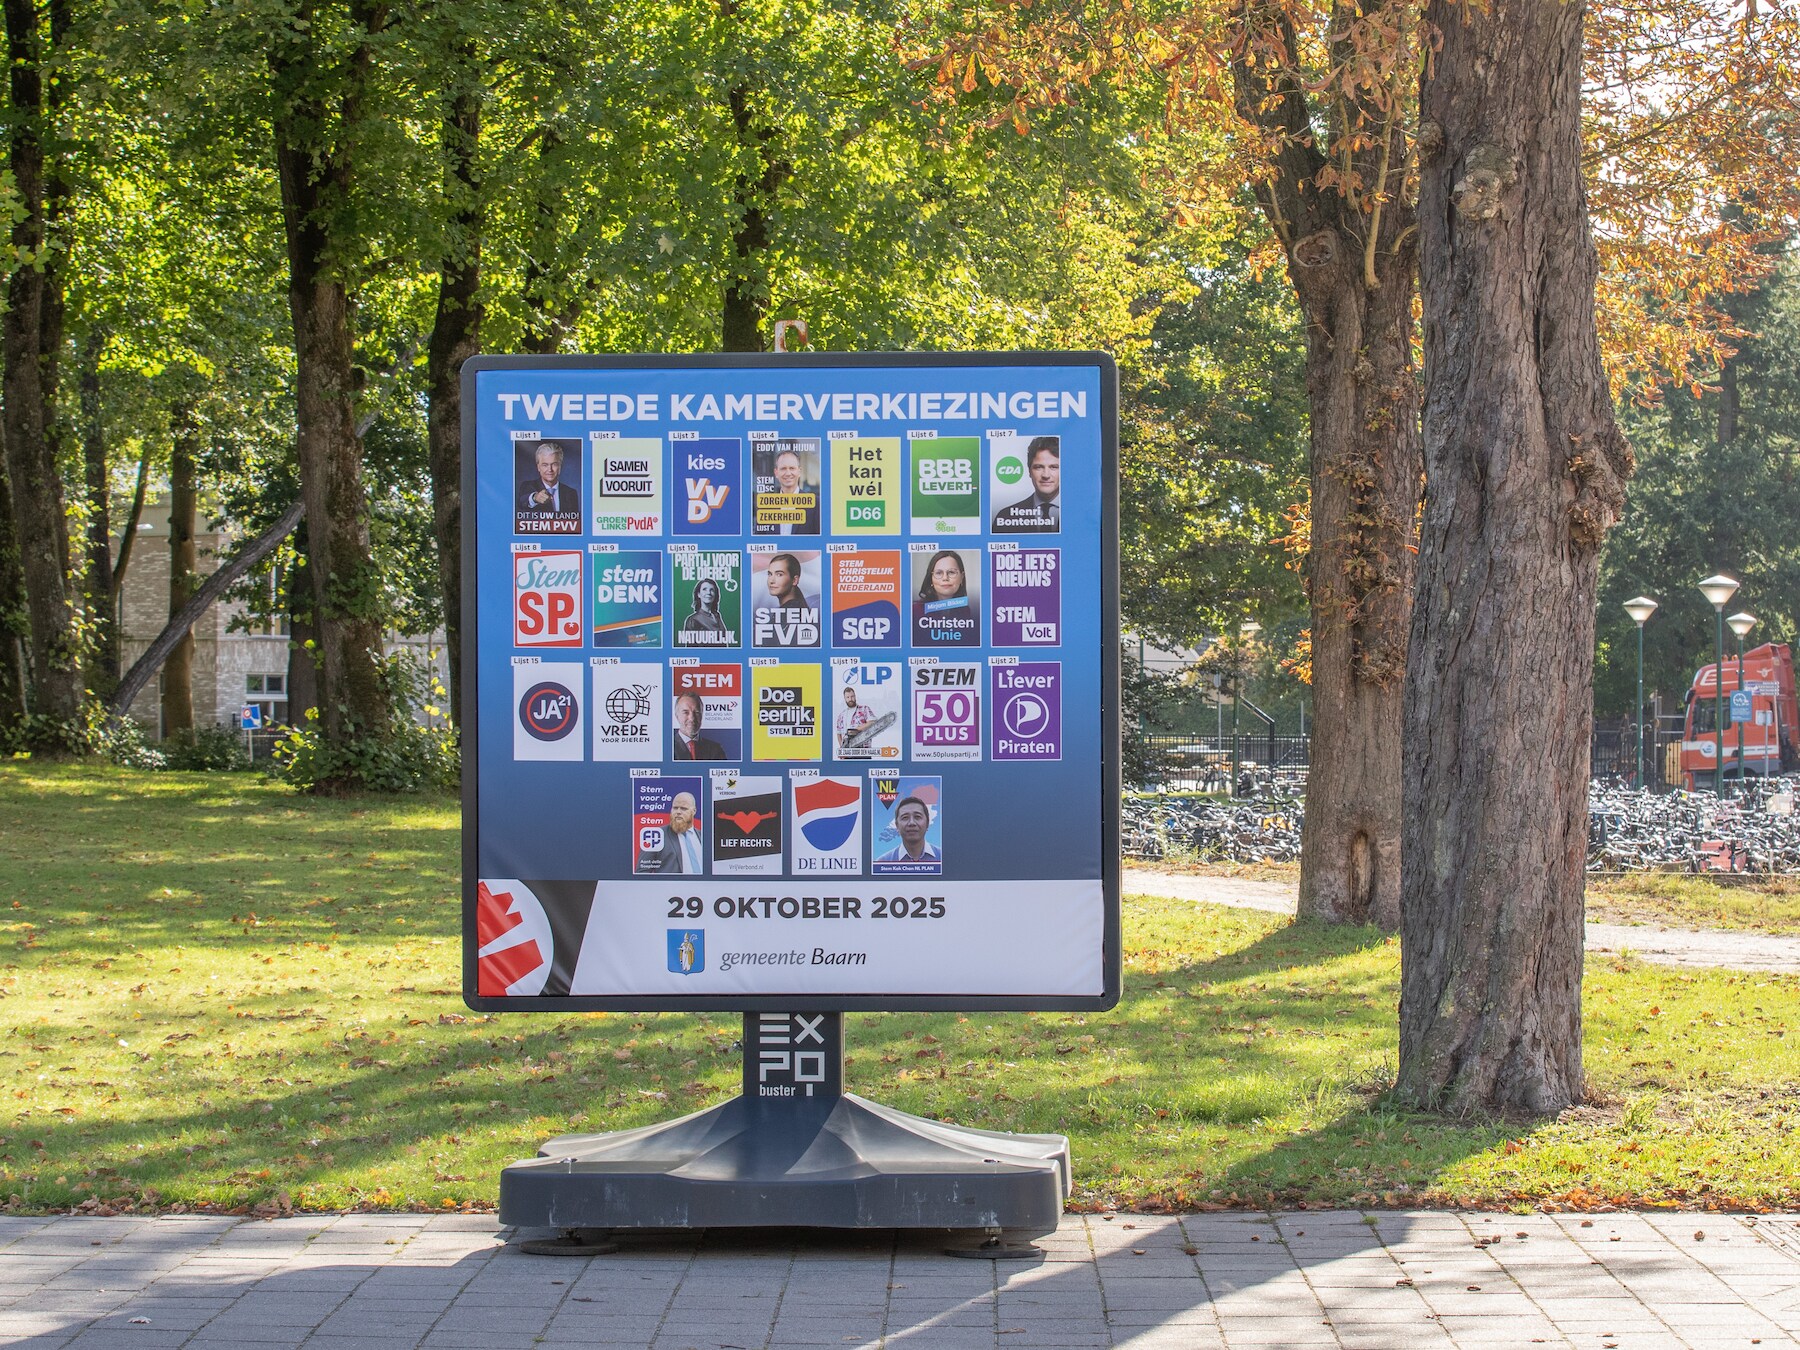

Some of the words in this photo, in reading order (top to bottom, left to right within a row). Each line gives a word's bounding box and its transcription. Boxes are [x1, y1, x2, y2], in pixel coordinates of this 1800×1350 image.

[498, 394, 659, 420] TWEEDE
[670, 392, 1086, 420] KAMERVERKIEZINGEN
[850, 447, 882, 461] Het
[610, 461, 648, 472] SAMEN
[688, 454, 725, 470] kies
[919, 459, 972, 478] BBB
[850, 465, 882, 478] kan
[998, 466, 1021, 475] CDA
[606, 481, 652, 491] VOORUIT
[850, 482, 882, 495] wél
[922, 482, 971, 490] LEVERT
[760, 497, 789, 505] ZORGEN
[792, 497, 812, 505] VOOR
[760, 513, 803, 521] ZEKERHEID!
[850, 507, 881, 520] D66
[1010, 506, 1040, 516] Henri
[519, 521, 551, 531] STEM
[553, 521, 577, 531] PVV
[628, 517, 653, 530] PvdA
[996, 517, 1054, 526] Bontenbal
[675, 554, 710, 567] PARTIJ
[712, 553, 739, 567] VOOR
[996, 554, 1022, 570] DOE
[1026, 554, 1056, 570] IETS
[516, 559, 580, 589] Stem
[602, 565, 653, 582] stem
[682, 567, 695, 580] DE
[697, 567, 732, 580] DIEREN
[996, 571, 1051, 587] NIEUWS
[598, 585, 658, 603] DENK
[756, 608, 818, 623] STEM
[996, 607, 1035, 623] STEM
[843, 618, 890, 640] SGP
[919, 617, 974, 628] Christen
[678, 631, 737, 644] NATUURLIJK.
[755, 624, 818, 645] FVD
[931, 630, 961, 640] Unie
[1027, 627, 1052, 638] Volt
[682, 674, 732, 688] STEM
[861, 667, 892, 684] LP
[916, 669, 976, 685] STEM
[998, 670, 1054, 688] Liever
[760, 687, 794, 702] Doe
[922, 693, 970, 723] 50
[759, 706, 815, 725] eerlijk.
[601, 725, 647, 735] VREDE
[923, 727, 968, 740] PLUS
[999, 740, 1054, 753] Piraten
[879, 781, 895, 793] NL
[640, 803, 665, 811] regio!
[721, 839, 738, 847] LIEF
[798, 858, 816, 869] DE
[820, 858, 857, 869] LINIE
[667, 897, 703, 918] 29
[714, 897, 861, 918] OKTOBER
[871, 897, 946, 918] 2025
[720, 949, 806, 971] gemeente
[811, 948, 866, 965] Baarn
[760, 1084, 795, 1096] buster
